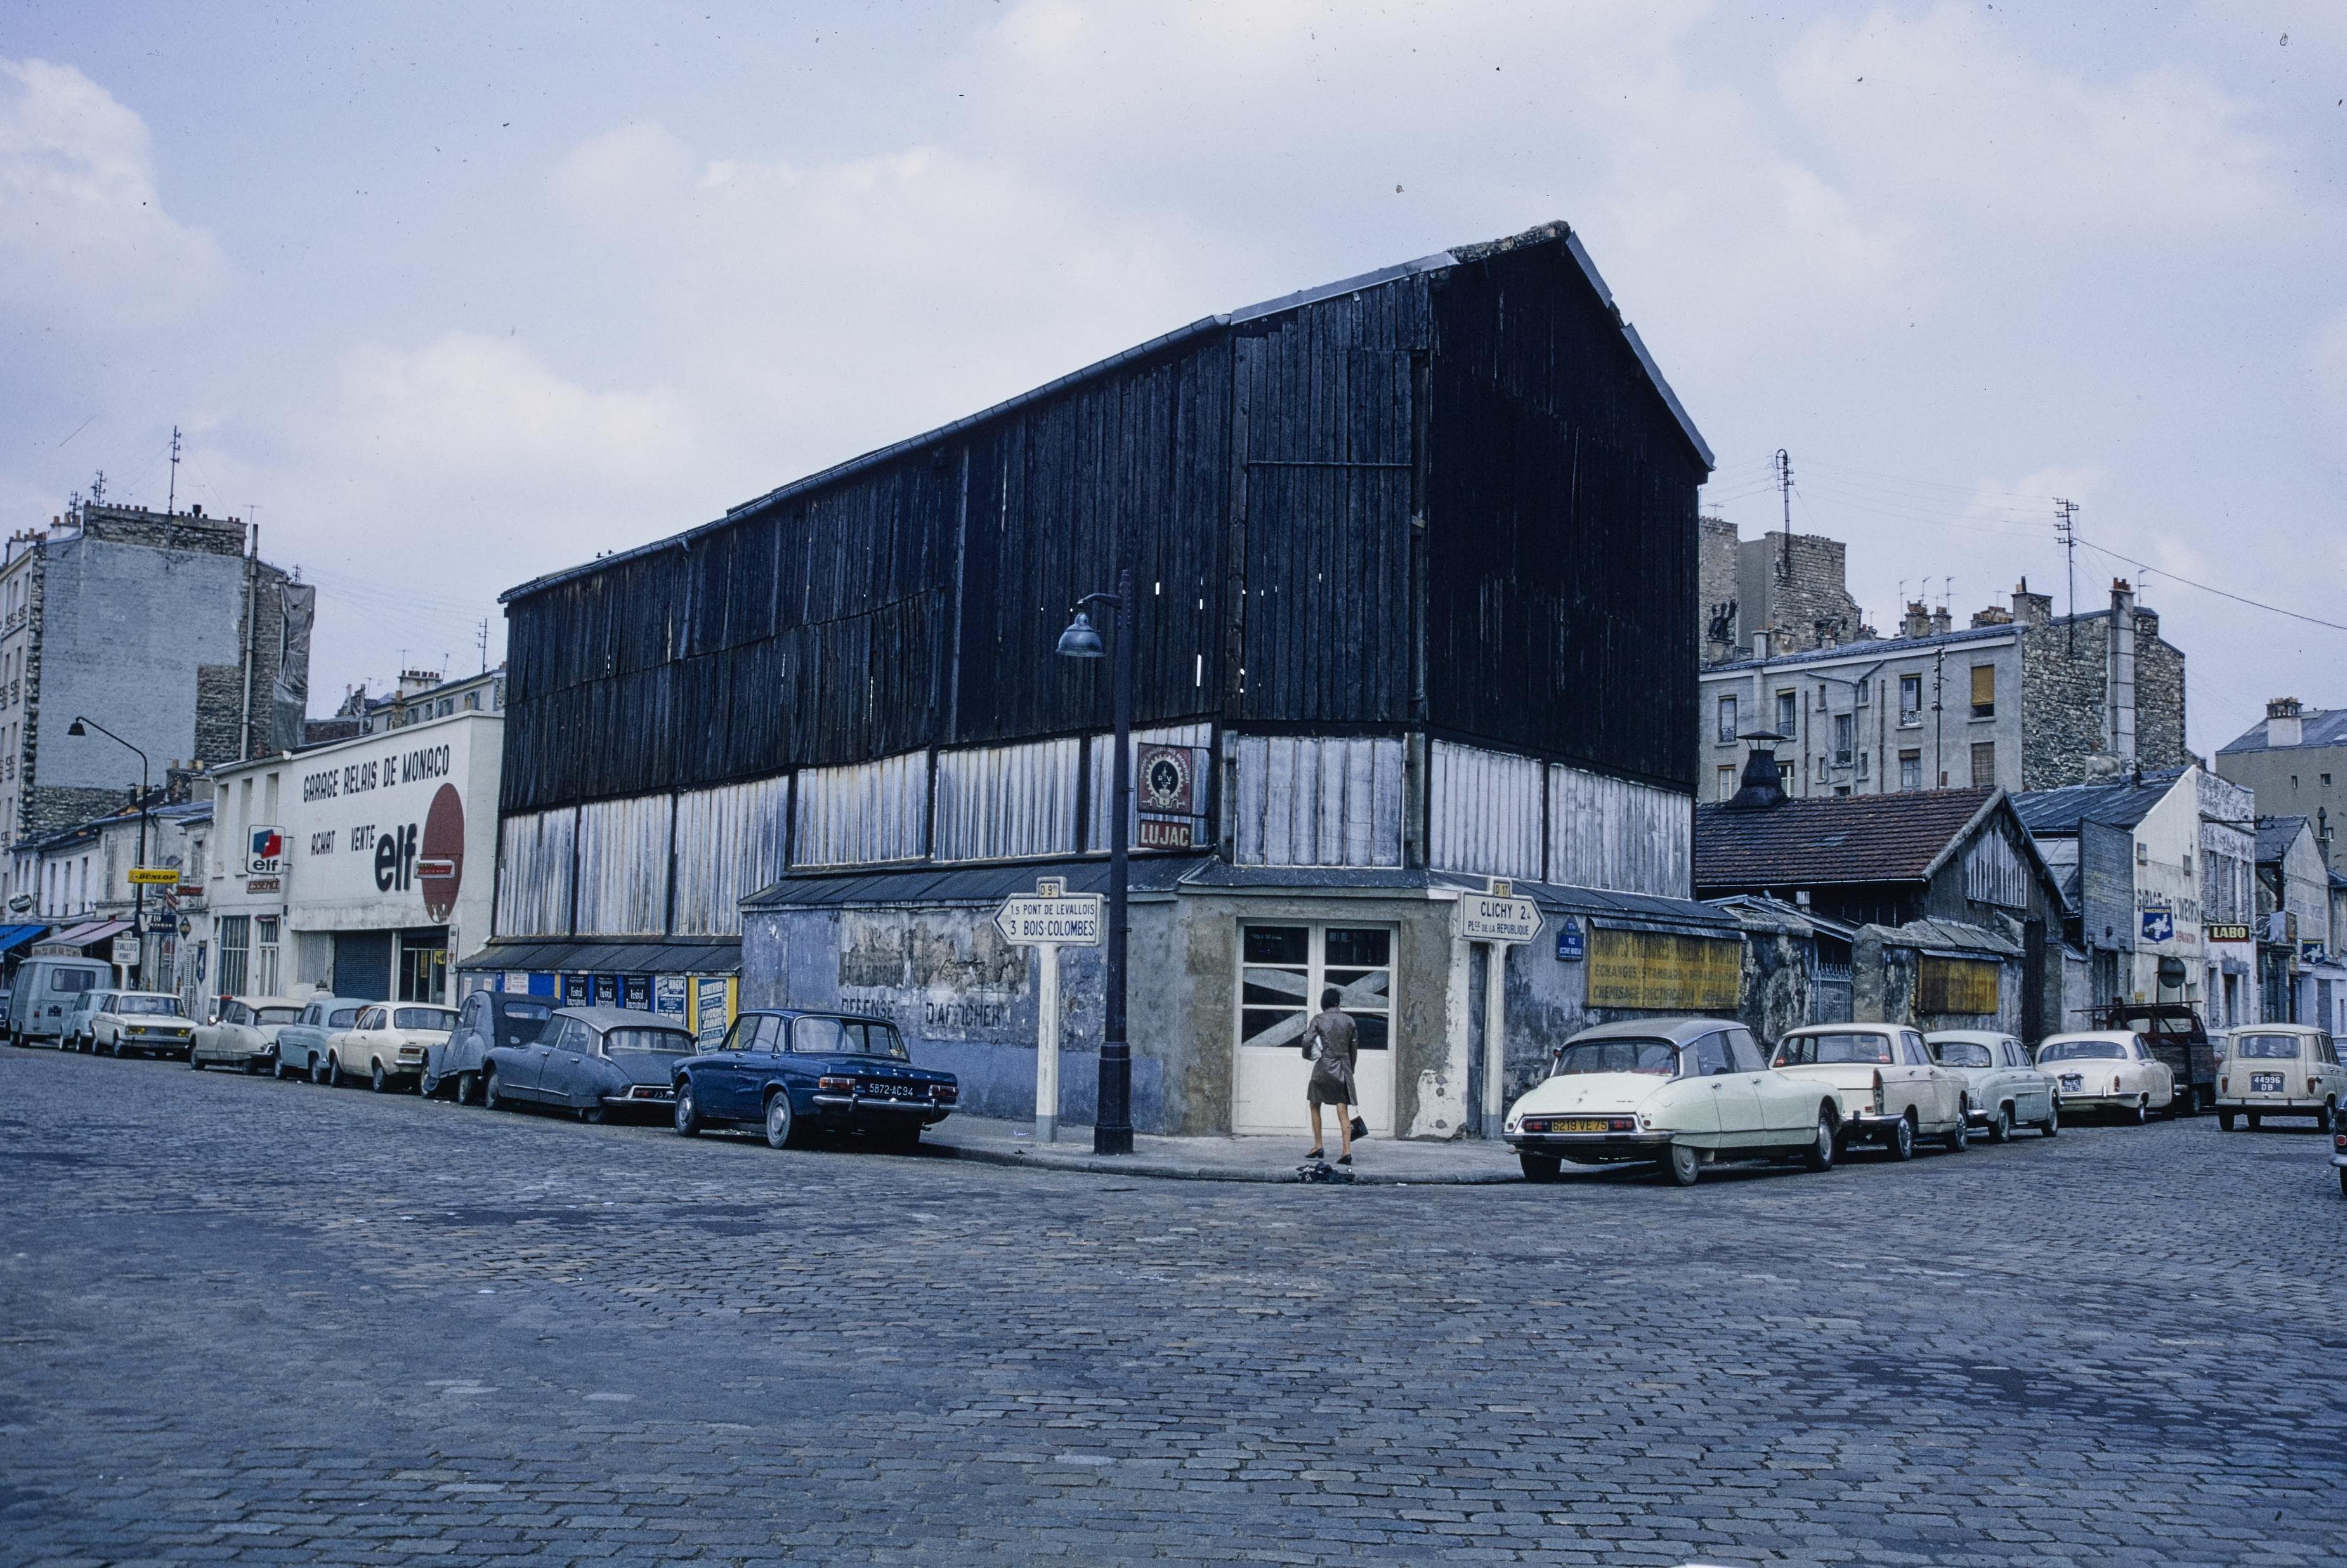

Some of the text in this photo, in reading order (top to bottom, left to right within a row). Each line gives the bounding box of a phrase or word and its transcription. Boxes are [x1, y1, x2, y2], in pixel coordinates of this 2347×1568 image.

[303, 744, 450, 803] GARAGE RELAIS DE MONACO
[311, 830, 336, 856] ACHAT
[351, 825, 376, 852] VENTE
[1141, 824, 1189, 847] LUJAC
[374, 823, 417, 892] elf
[252, 859, 278, 872] elf
[1040, 885, 1045, 895] D
[1496, 885, 1508, 894] D 17
[1023, 904, 1042, 915] PONT
[1044, 905, 1053, 915] DE
[1056, 904, 1095, 915] LEVALLOIS
[1481, 901, 1513, 919] CLICHY
[1010, 920, 1016, 935] 3
[1482, 924, 1488, 932] DE
[2213, 927, 2246, 938] LABO
[114, 943, 137, 951] LEVALLOIS
[1593, 984, 1639, 1000] CHEMISAGE
[842, 998, 895, 1020] DEFENSE
[1553, 1120, 1607, 1131] 6219 VE 75
